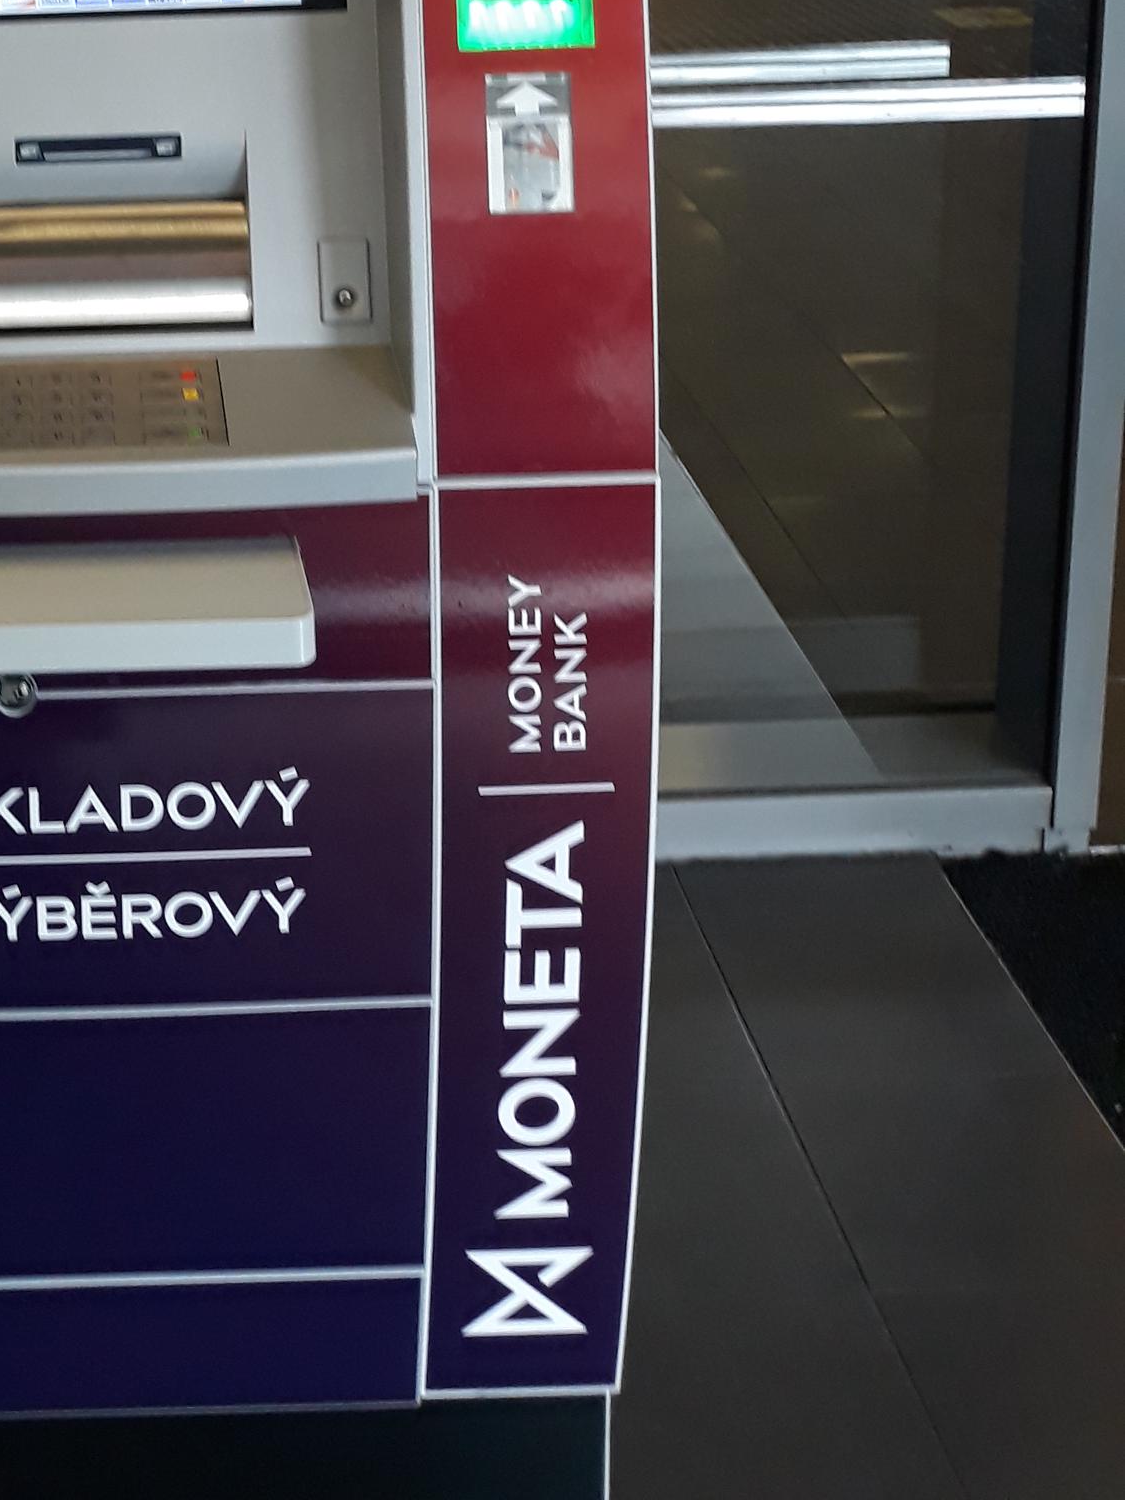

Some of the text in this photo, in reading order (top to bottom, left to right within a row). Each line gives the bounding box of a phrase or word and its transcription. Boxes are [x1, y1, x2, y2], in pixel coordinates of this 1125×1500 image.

[507, 574, 542, 753] MONEY
[553, 611, 588, 752] BANK
[493, 819, 586, 1220] MONETA
